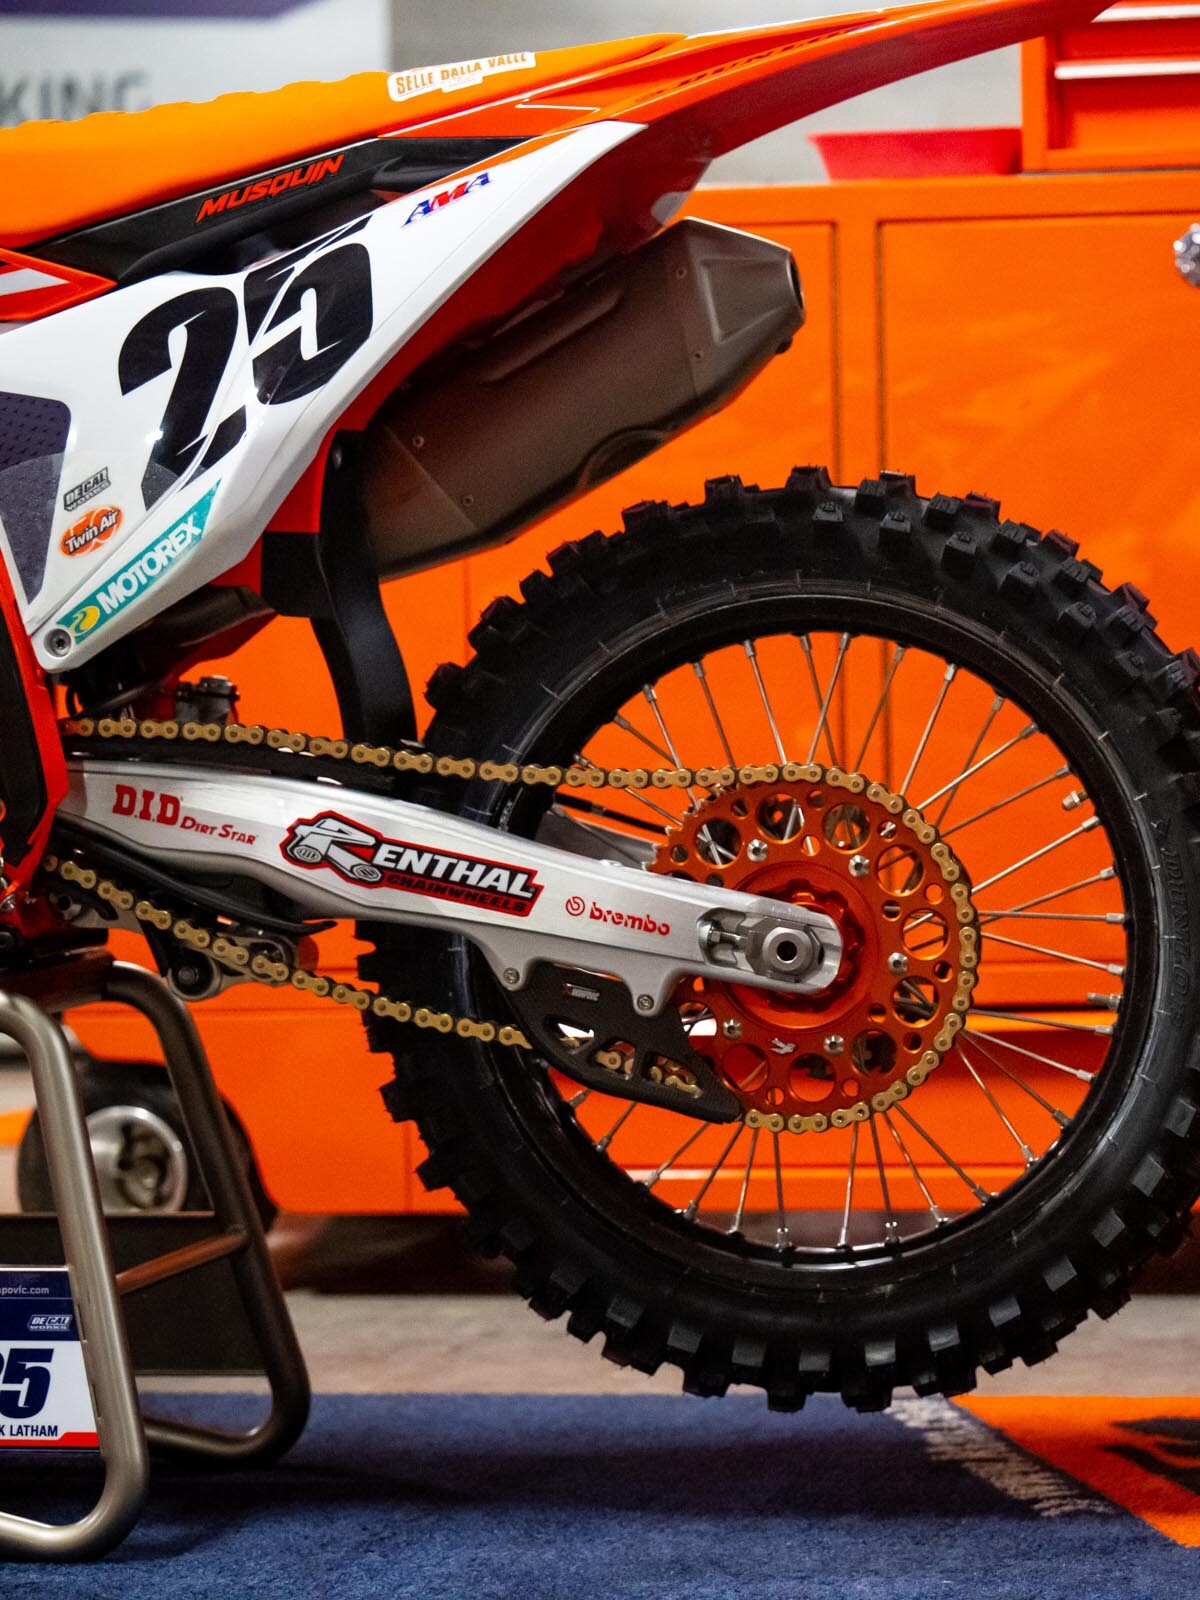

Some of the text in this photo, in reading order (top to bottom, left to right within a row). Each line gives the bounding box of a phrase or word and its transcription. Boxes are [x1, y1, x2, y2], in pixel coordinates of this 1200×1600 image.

[395, 71, 434, 95] SELLE
[440, 61, 482, 81] DALLA
[195, 153, 345, 224] MUSQUIN
[404, 172, 490, 226] AMA
[118, 214, 374, 511] 25
[65, 509, 121, 555] Twin Air
[96, 513, 202, 615] MOTOREX
[112, 783, 181, 826] D.I.D
[288, 817, 535, 899] RENTHAL
[387, 874, 527, 912] CHAINWHEELS
[589, 902, 671, 936] brembo
[0, 1285, 50, 1296] povic.com
[0, 1348, 55, 1419] 5
[9, 1425, 59, 1437] LATHAM
